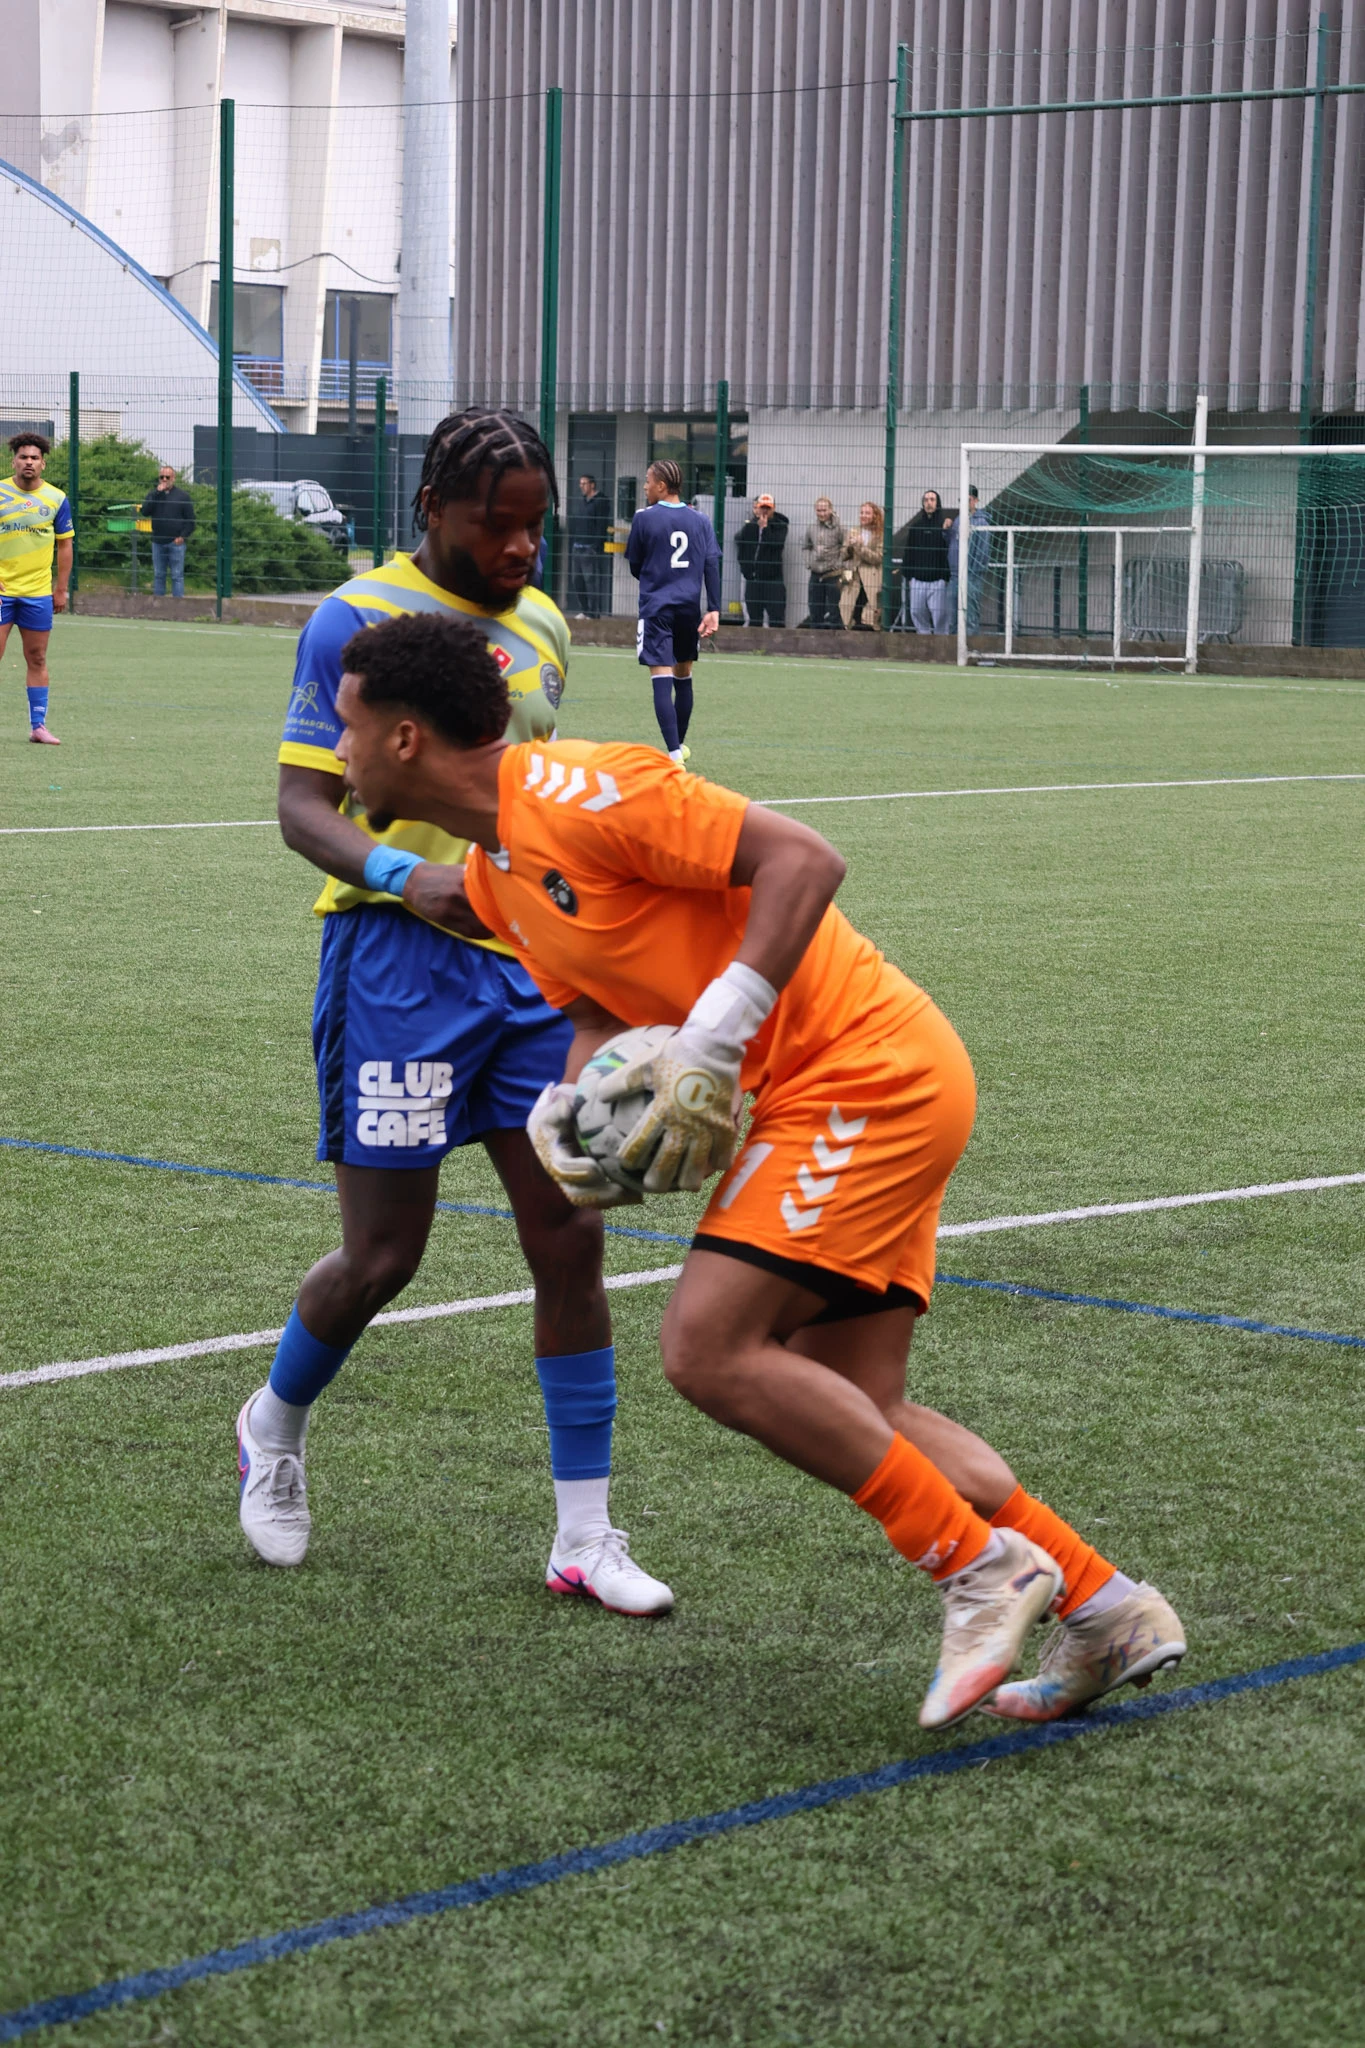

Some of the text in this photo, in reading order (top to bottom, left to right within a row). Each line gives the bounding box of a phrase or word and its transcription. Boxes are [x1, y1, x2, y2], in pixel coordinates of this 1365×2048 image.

[670, 531, 689, 568] 2
[358, 1061, 453, 1097] CLUB
[357, 1109, 447, 1146] CAFE
